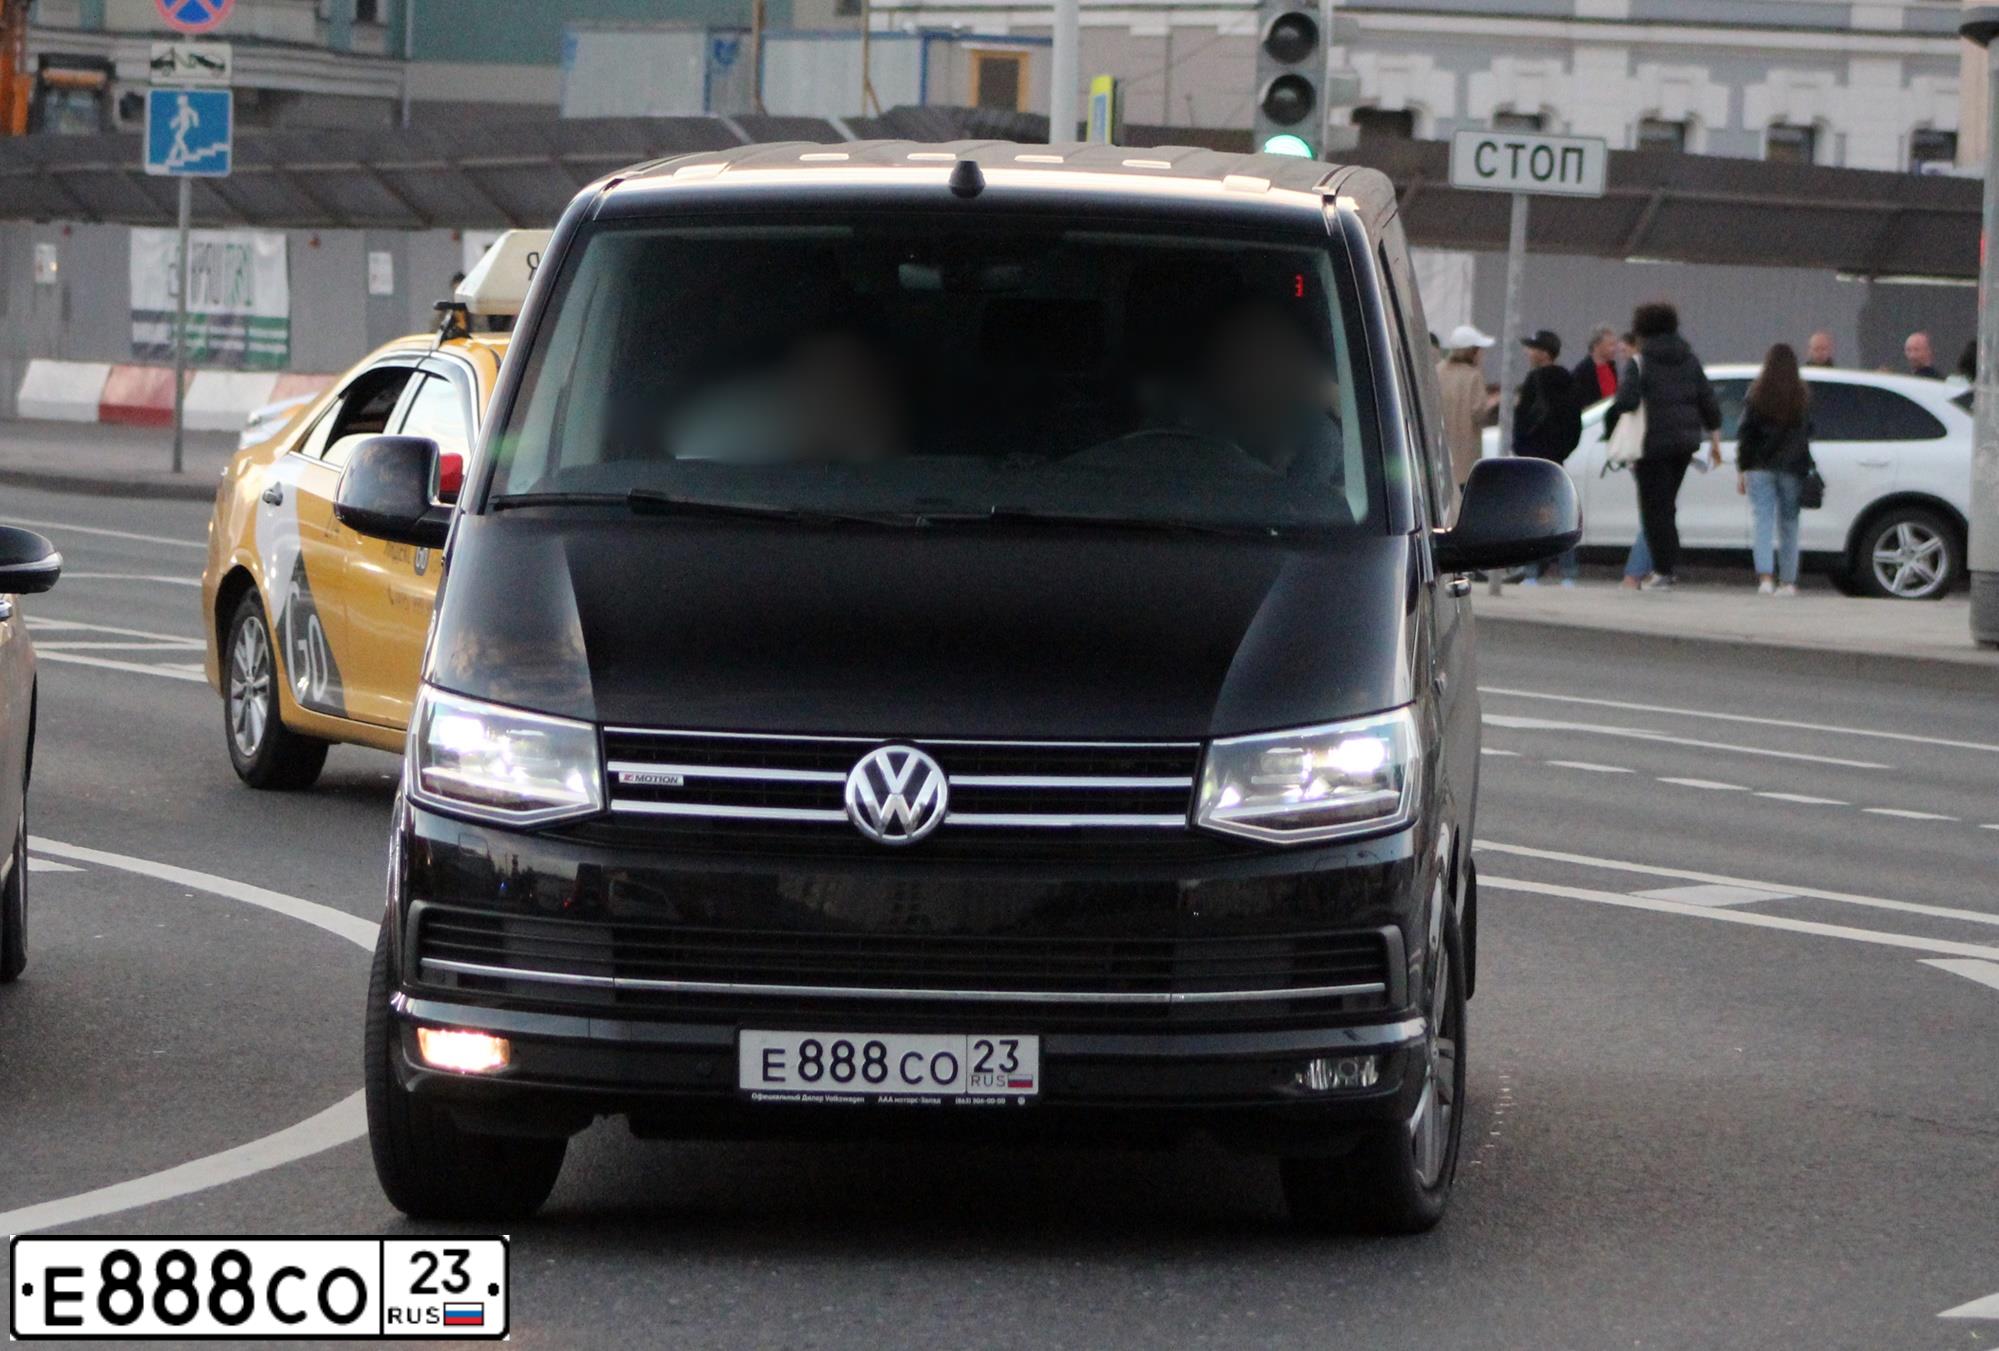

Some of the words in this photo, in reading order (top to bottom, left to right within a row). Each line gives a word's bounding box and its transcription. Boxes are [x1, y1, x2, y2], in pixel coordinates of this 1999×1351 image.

[1474, 140, 1584, 184] СТОП
[973, 1039, 1020, 1073] 23
[970, 1074, 1006, 1088] RUS
